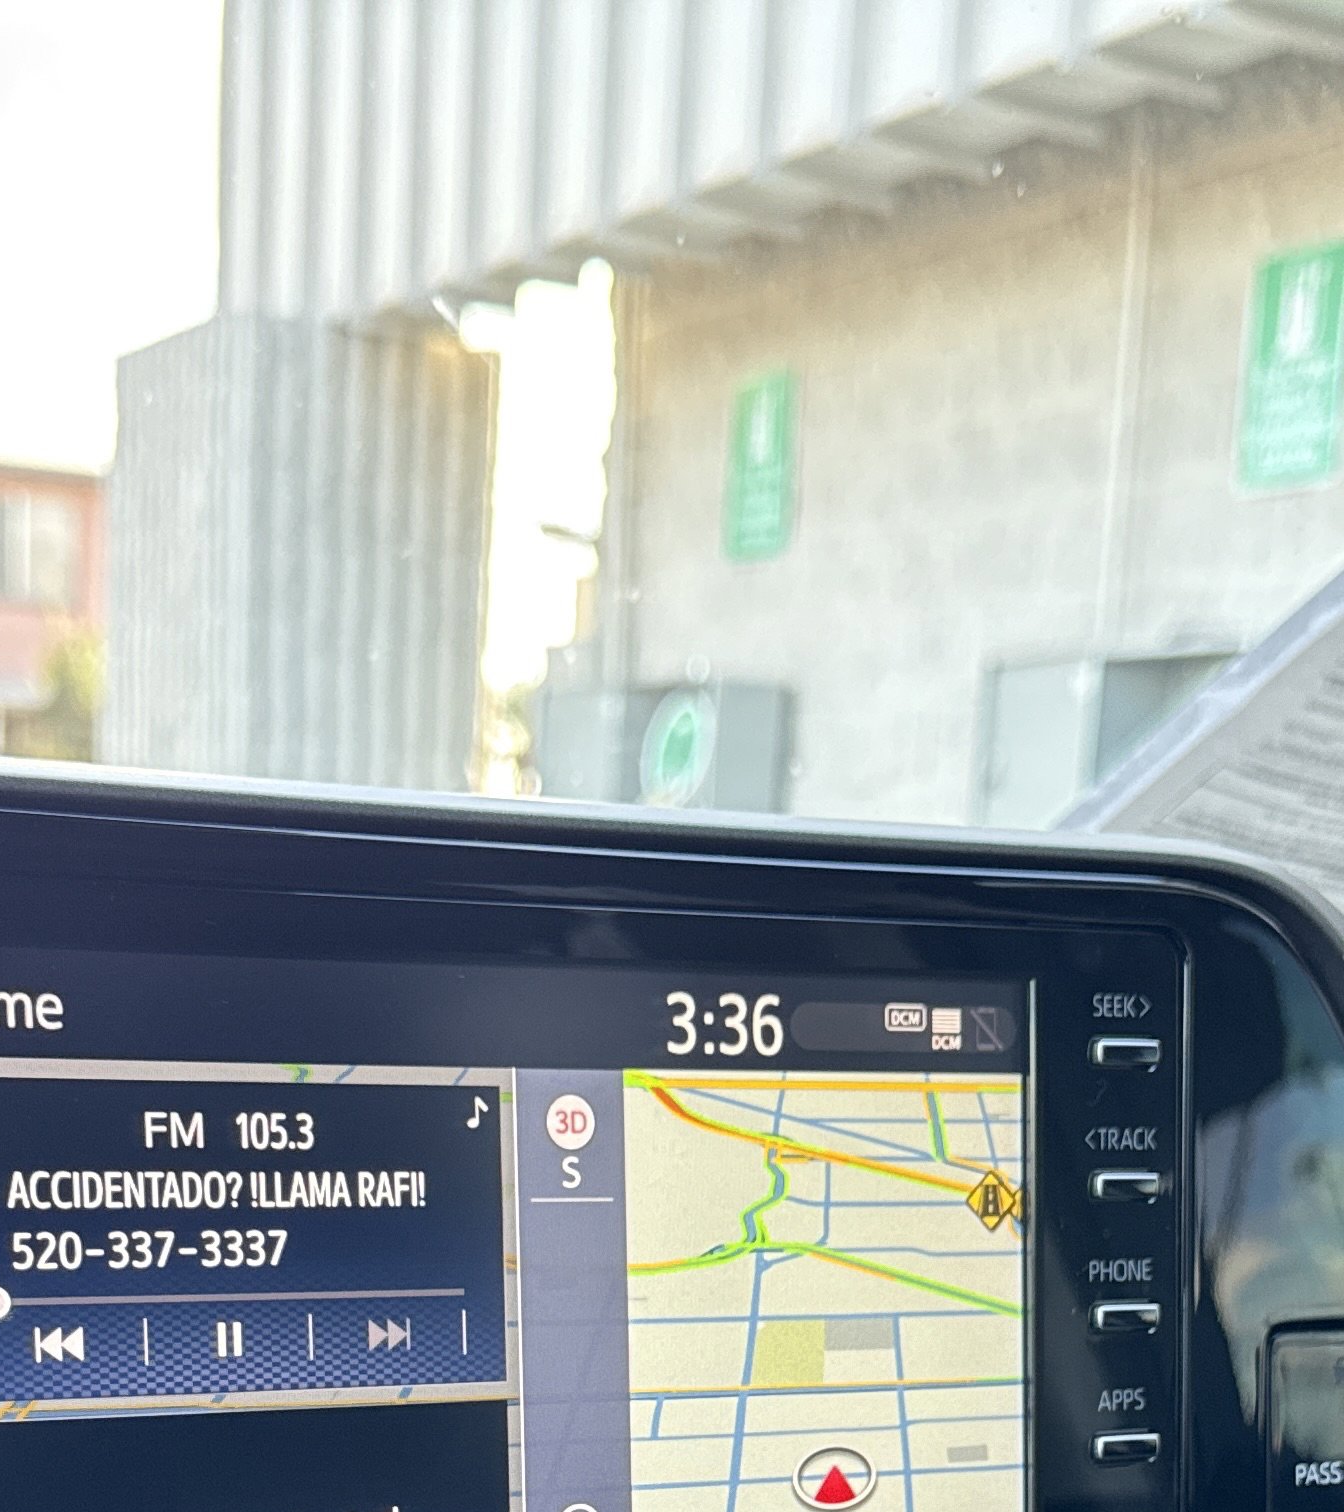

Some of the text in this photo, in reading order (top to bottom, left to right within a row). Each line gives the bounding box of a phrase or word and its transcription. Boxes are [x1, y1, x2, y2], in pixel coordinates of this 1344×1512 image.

[665, 991, 785, 1058] 3:36
[890, 1010, 922, 1026] DCM
[931, 1034, 961, 1051] DCM
[144, 1112, 316, 1152] FM 105.3
[554, 1108, 588, 1136] 3D
[561, 1157, 583, 1189] S
[6, 1170, 426, 1210] ACCIDENTADO? !LLAMA RAFI!
[11, 1230, 288, 1272] 520-337-3337
[1088, 1258, 1153, 1283] PHONE
[1098, 1387, 1145, 1412] APPS
[1295, 1461, 1344, 1487] PASS
